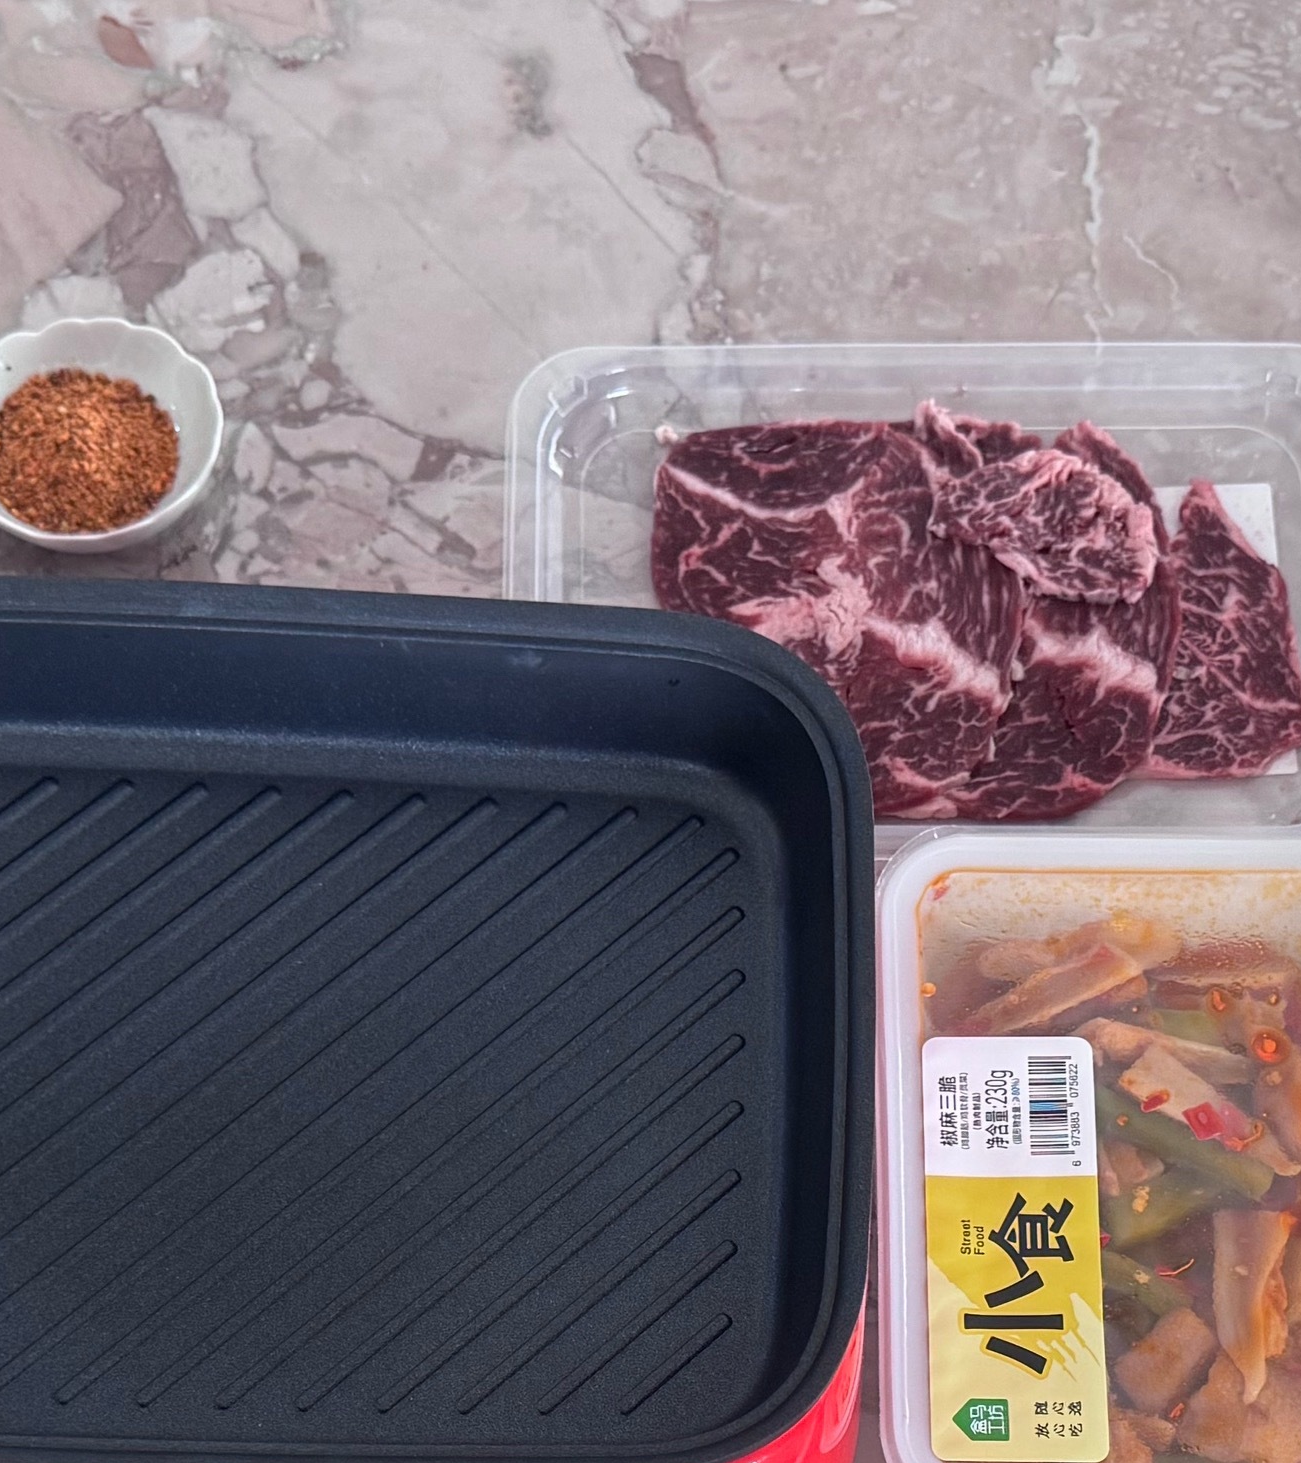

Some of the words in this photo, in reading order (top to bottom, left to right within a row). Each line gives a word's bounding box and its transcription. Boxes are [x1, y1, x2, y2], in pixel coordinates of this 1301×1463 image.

[960, 1219, 972, 1255] Street
[973, 1225, 985, 1255] Food
[964, 1192, 1075, 1375] 小食
